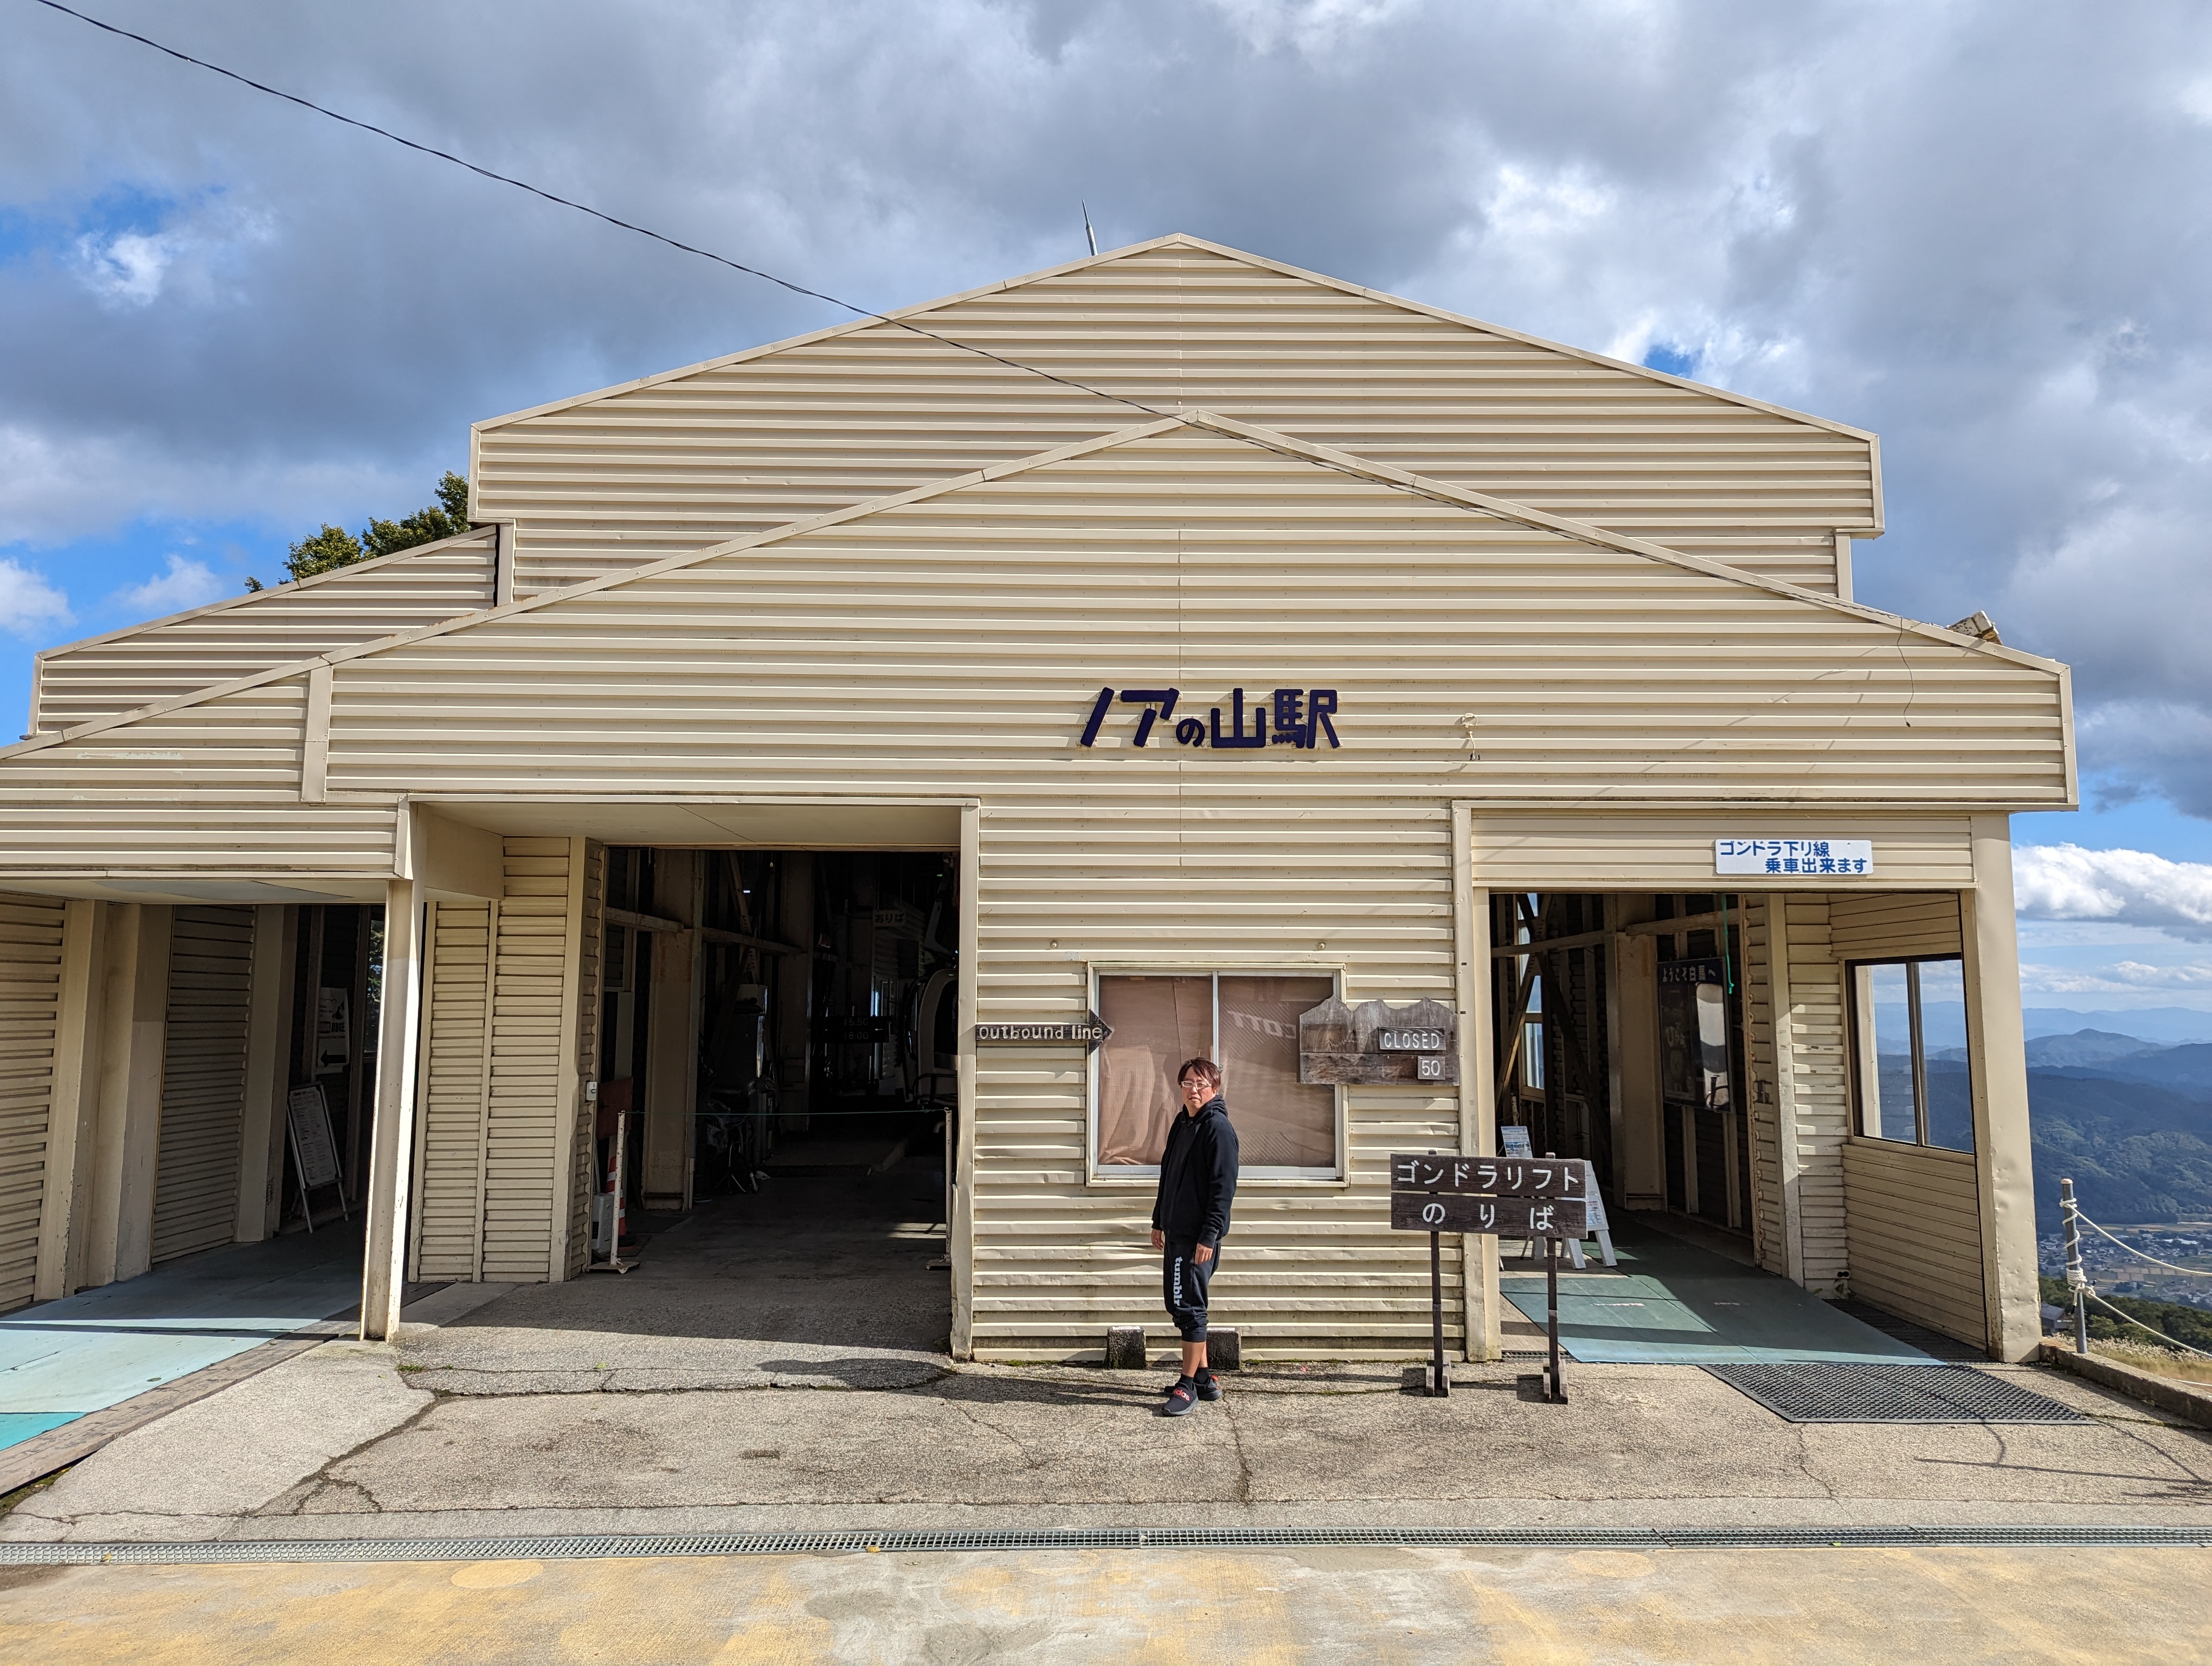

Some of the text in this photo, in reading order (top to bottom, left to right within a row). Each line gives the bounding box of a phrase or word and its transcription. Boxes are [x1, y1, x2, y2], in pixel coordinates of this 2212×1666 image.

[1080, 687, 1340, 748] ノアの山駅
[1720, 841, 1830, 857] ゴンドラ下り線
[1765, 858, 1867, 873] 乗車出来ます
[875, 913, 905, 923] おりば
[1072, 1025, 1102, 1039] line
[1384, 1033, 1440, 1049] CLOSED
[1422, 1060, 1441, 1076] 50
[1397, 1159, 1579, 1191] ゴンドラリフト
[1423, 1203, 1554, 1231] のりば
[1173, 1256, 1183, 1306] tumblr
